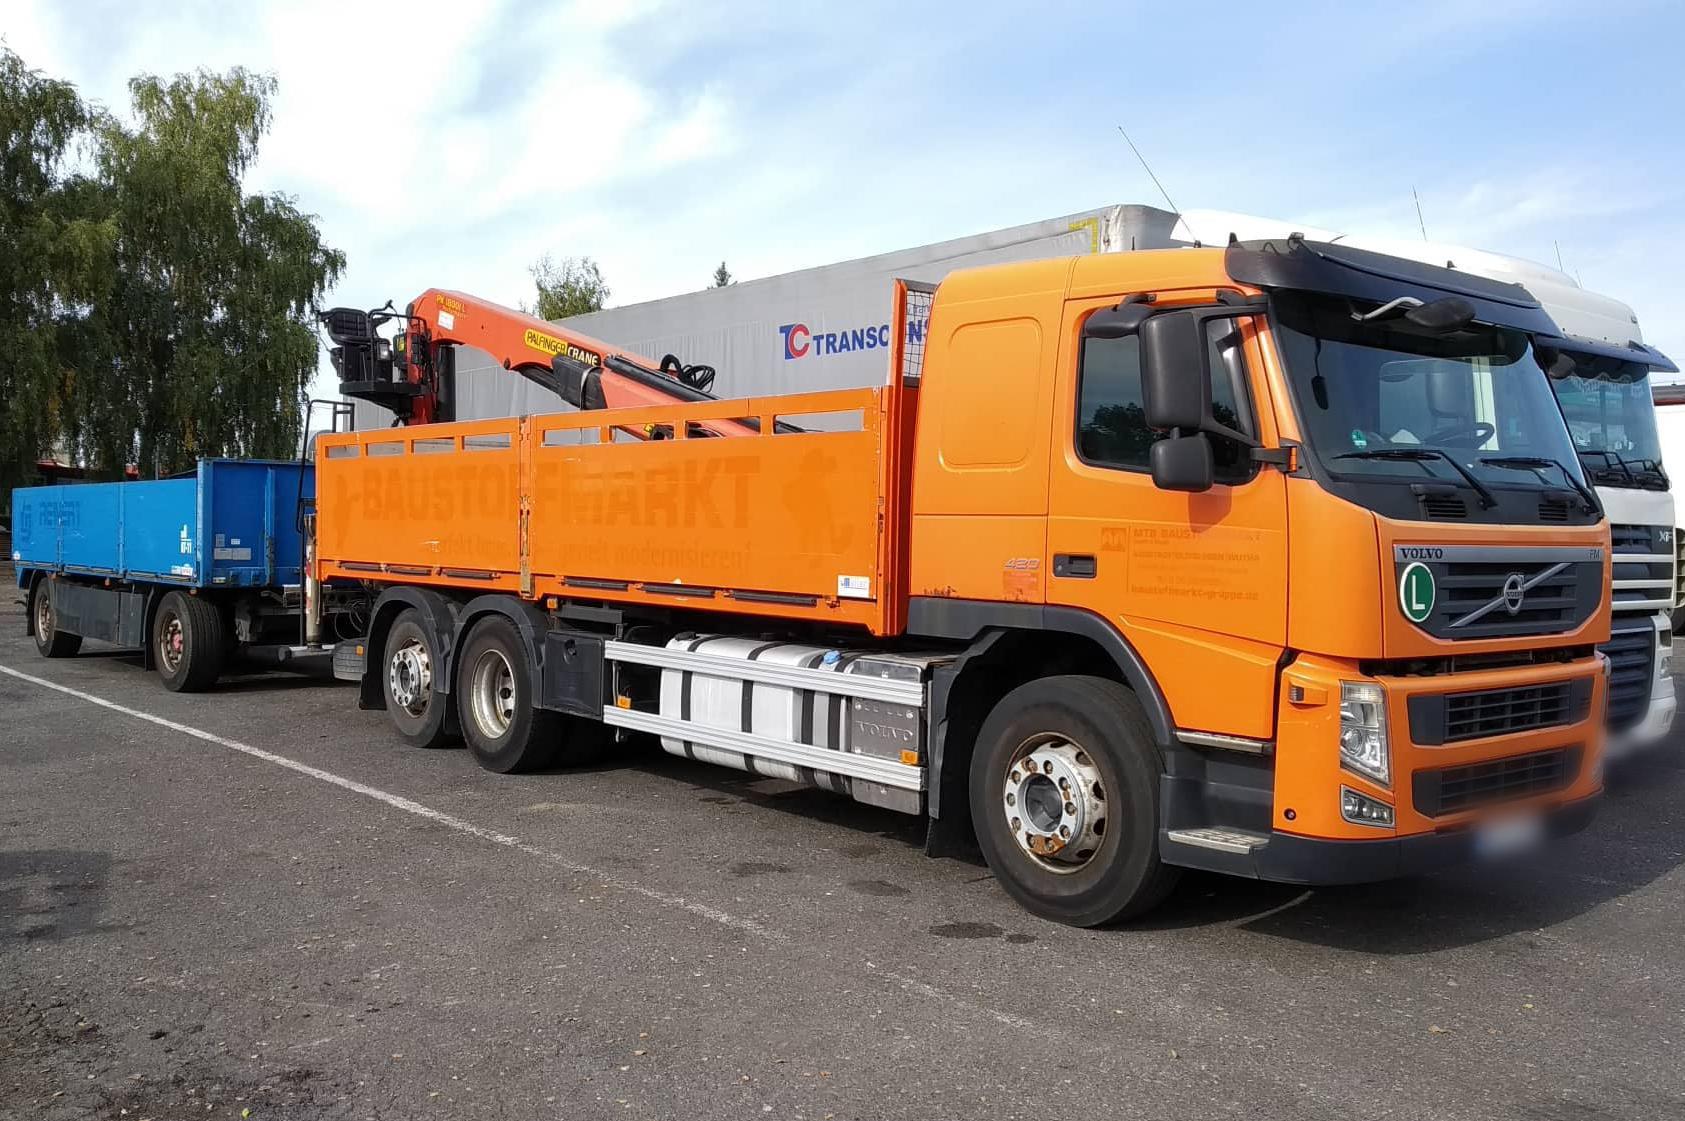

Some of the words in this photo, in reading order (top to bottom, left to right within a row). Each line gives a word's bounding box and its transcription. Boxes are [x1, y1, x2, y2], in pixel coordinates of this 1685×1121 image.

[526, 331, 567, 355] PALFINGER
[567, 345, 600, 368] CRANE
[1400, 547, 1444, 559] VOLVO
[1411, 574, 1426, 610] L
